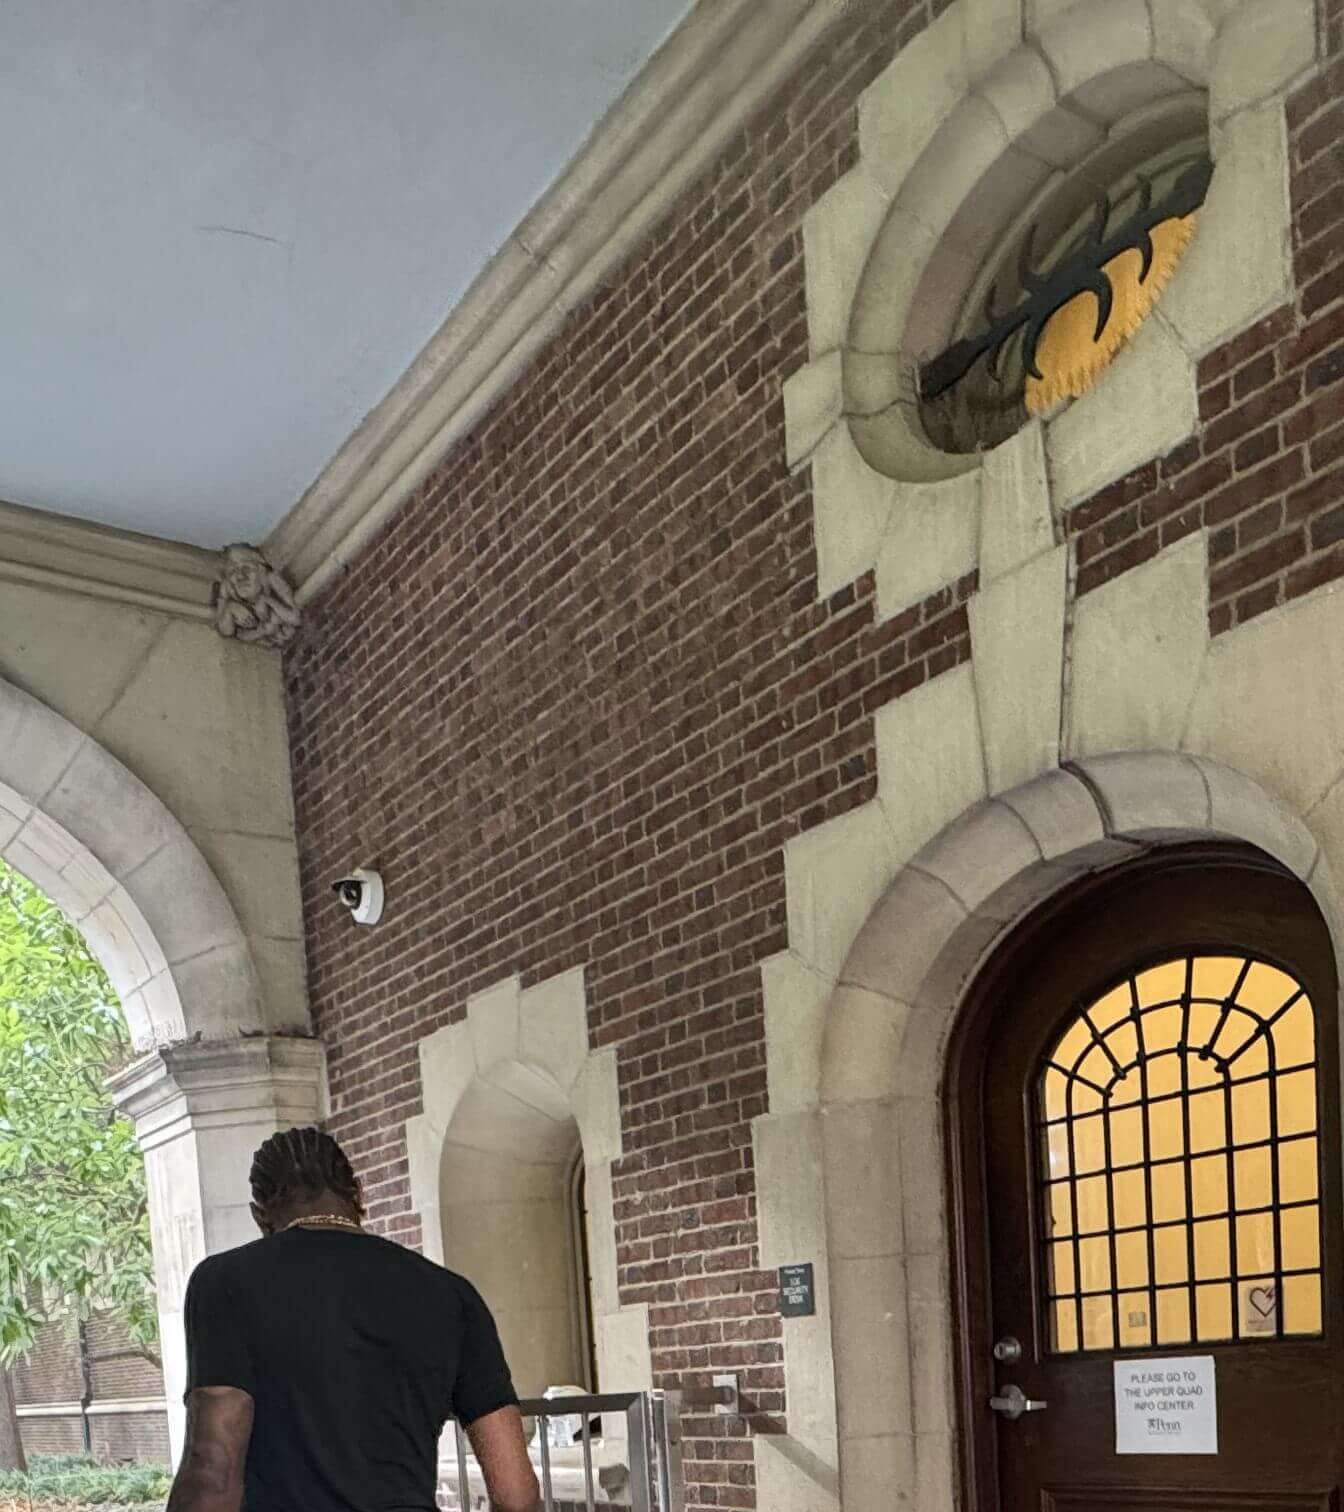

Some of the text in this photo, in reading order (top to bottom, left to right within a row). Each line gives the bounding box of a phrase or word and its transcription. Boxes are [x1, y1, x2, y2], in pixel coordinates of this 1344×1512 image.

[1130, 1371, 1196, 1383] PLEASE GO TO
[1124, 1385, 1203, 1398] THE UPPER QUAD
[1134, 1401, 1194, 1411] INFO CENTER
